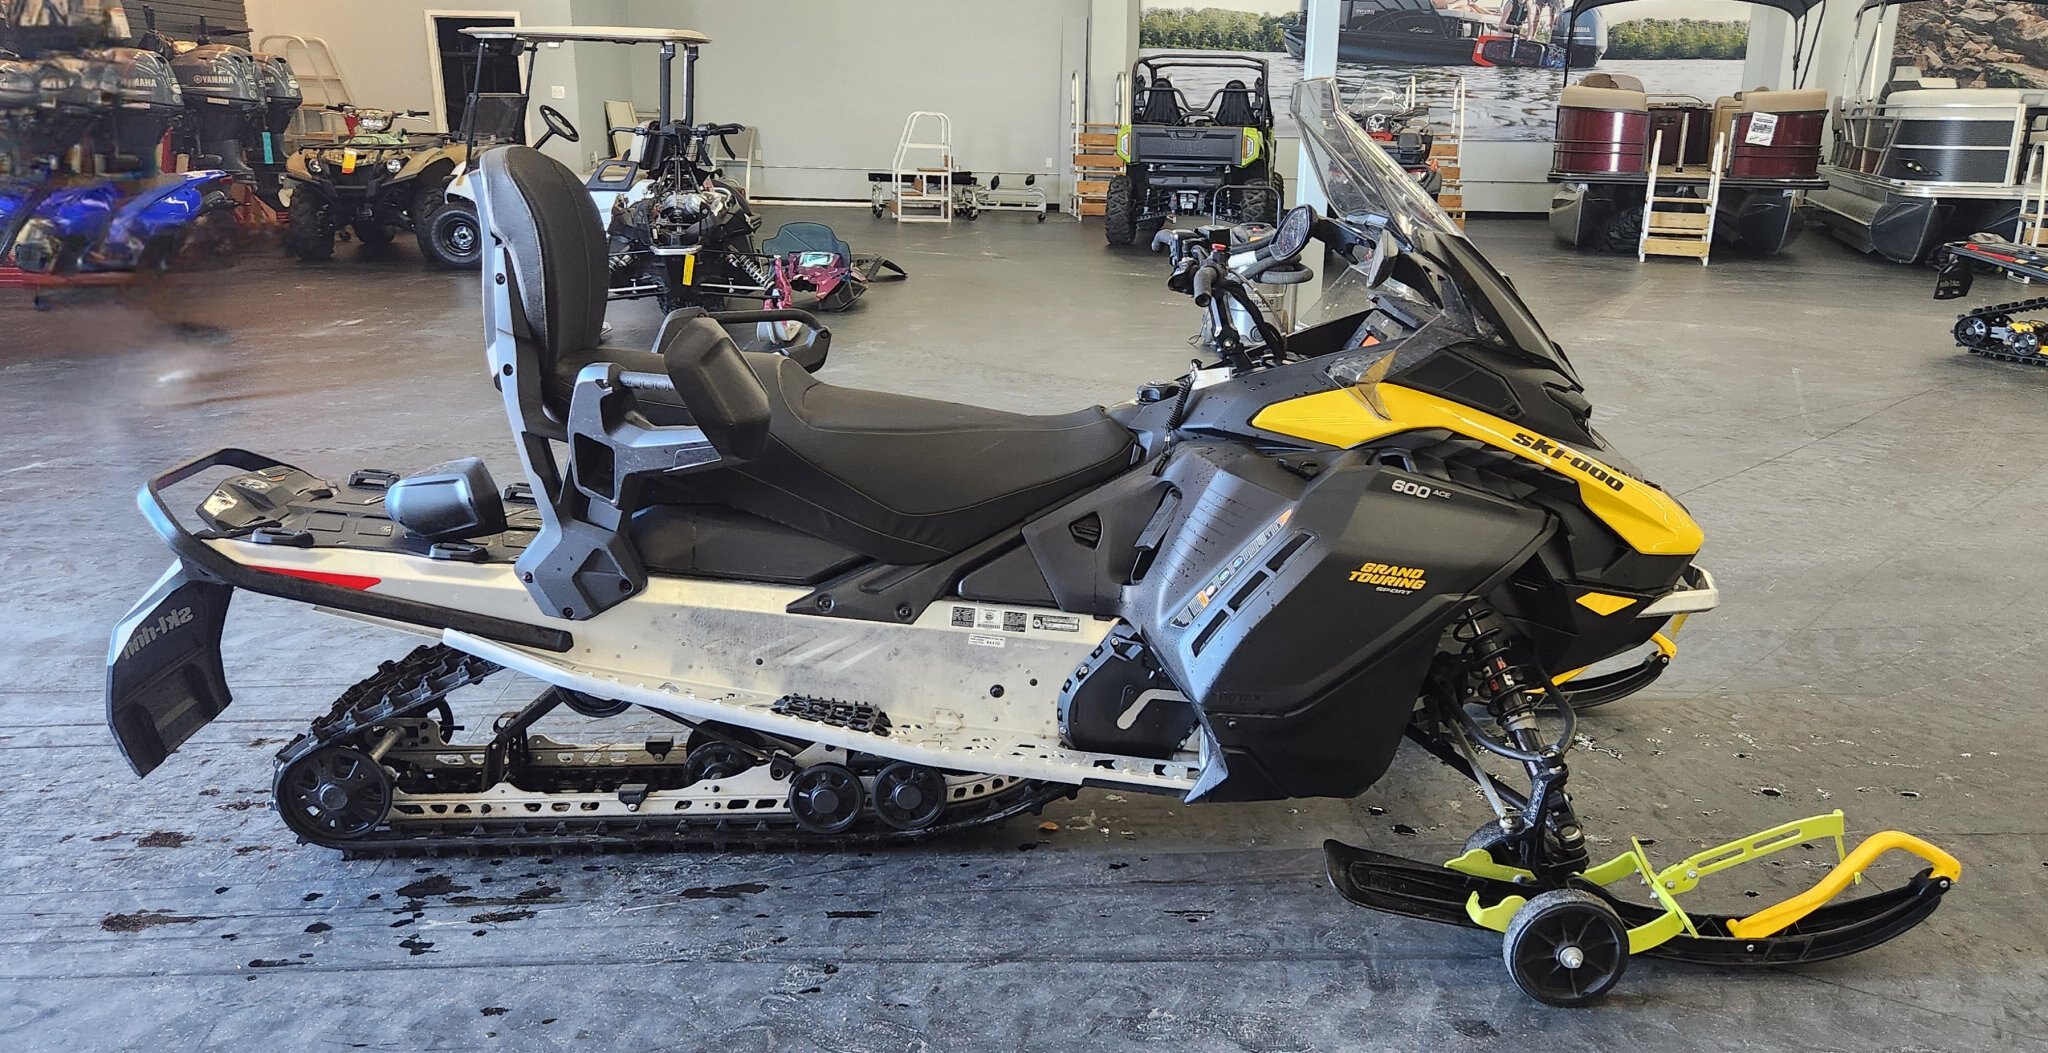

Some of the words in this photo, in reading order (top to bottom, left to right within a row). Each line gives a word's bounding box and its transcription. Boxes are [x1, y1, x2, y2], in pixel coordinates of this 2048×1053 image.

[201, 75, 235, 85] YAMAHA
[1391, 479, 1431, 499] 600
[1432, 489, 1452, 499] ACE
[1360, 562, 1425, 579] GRAND
[1348, 571, 1427, 590] TOURING
[1375, 586, 1413, 596] SPORT
